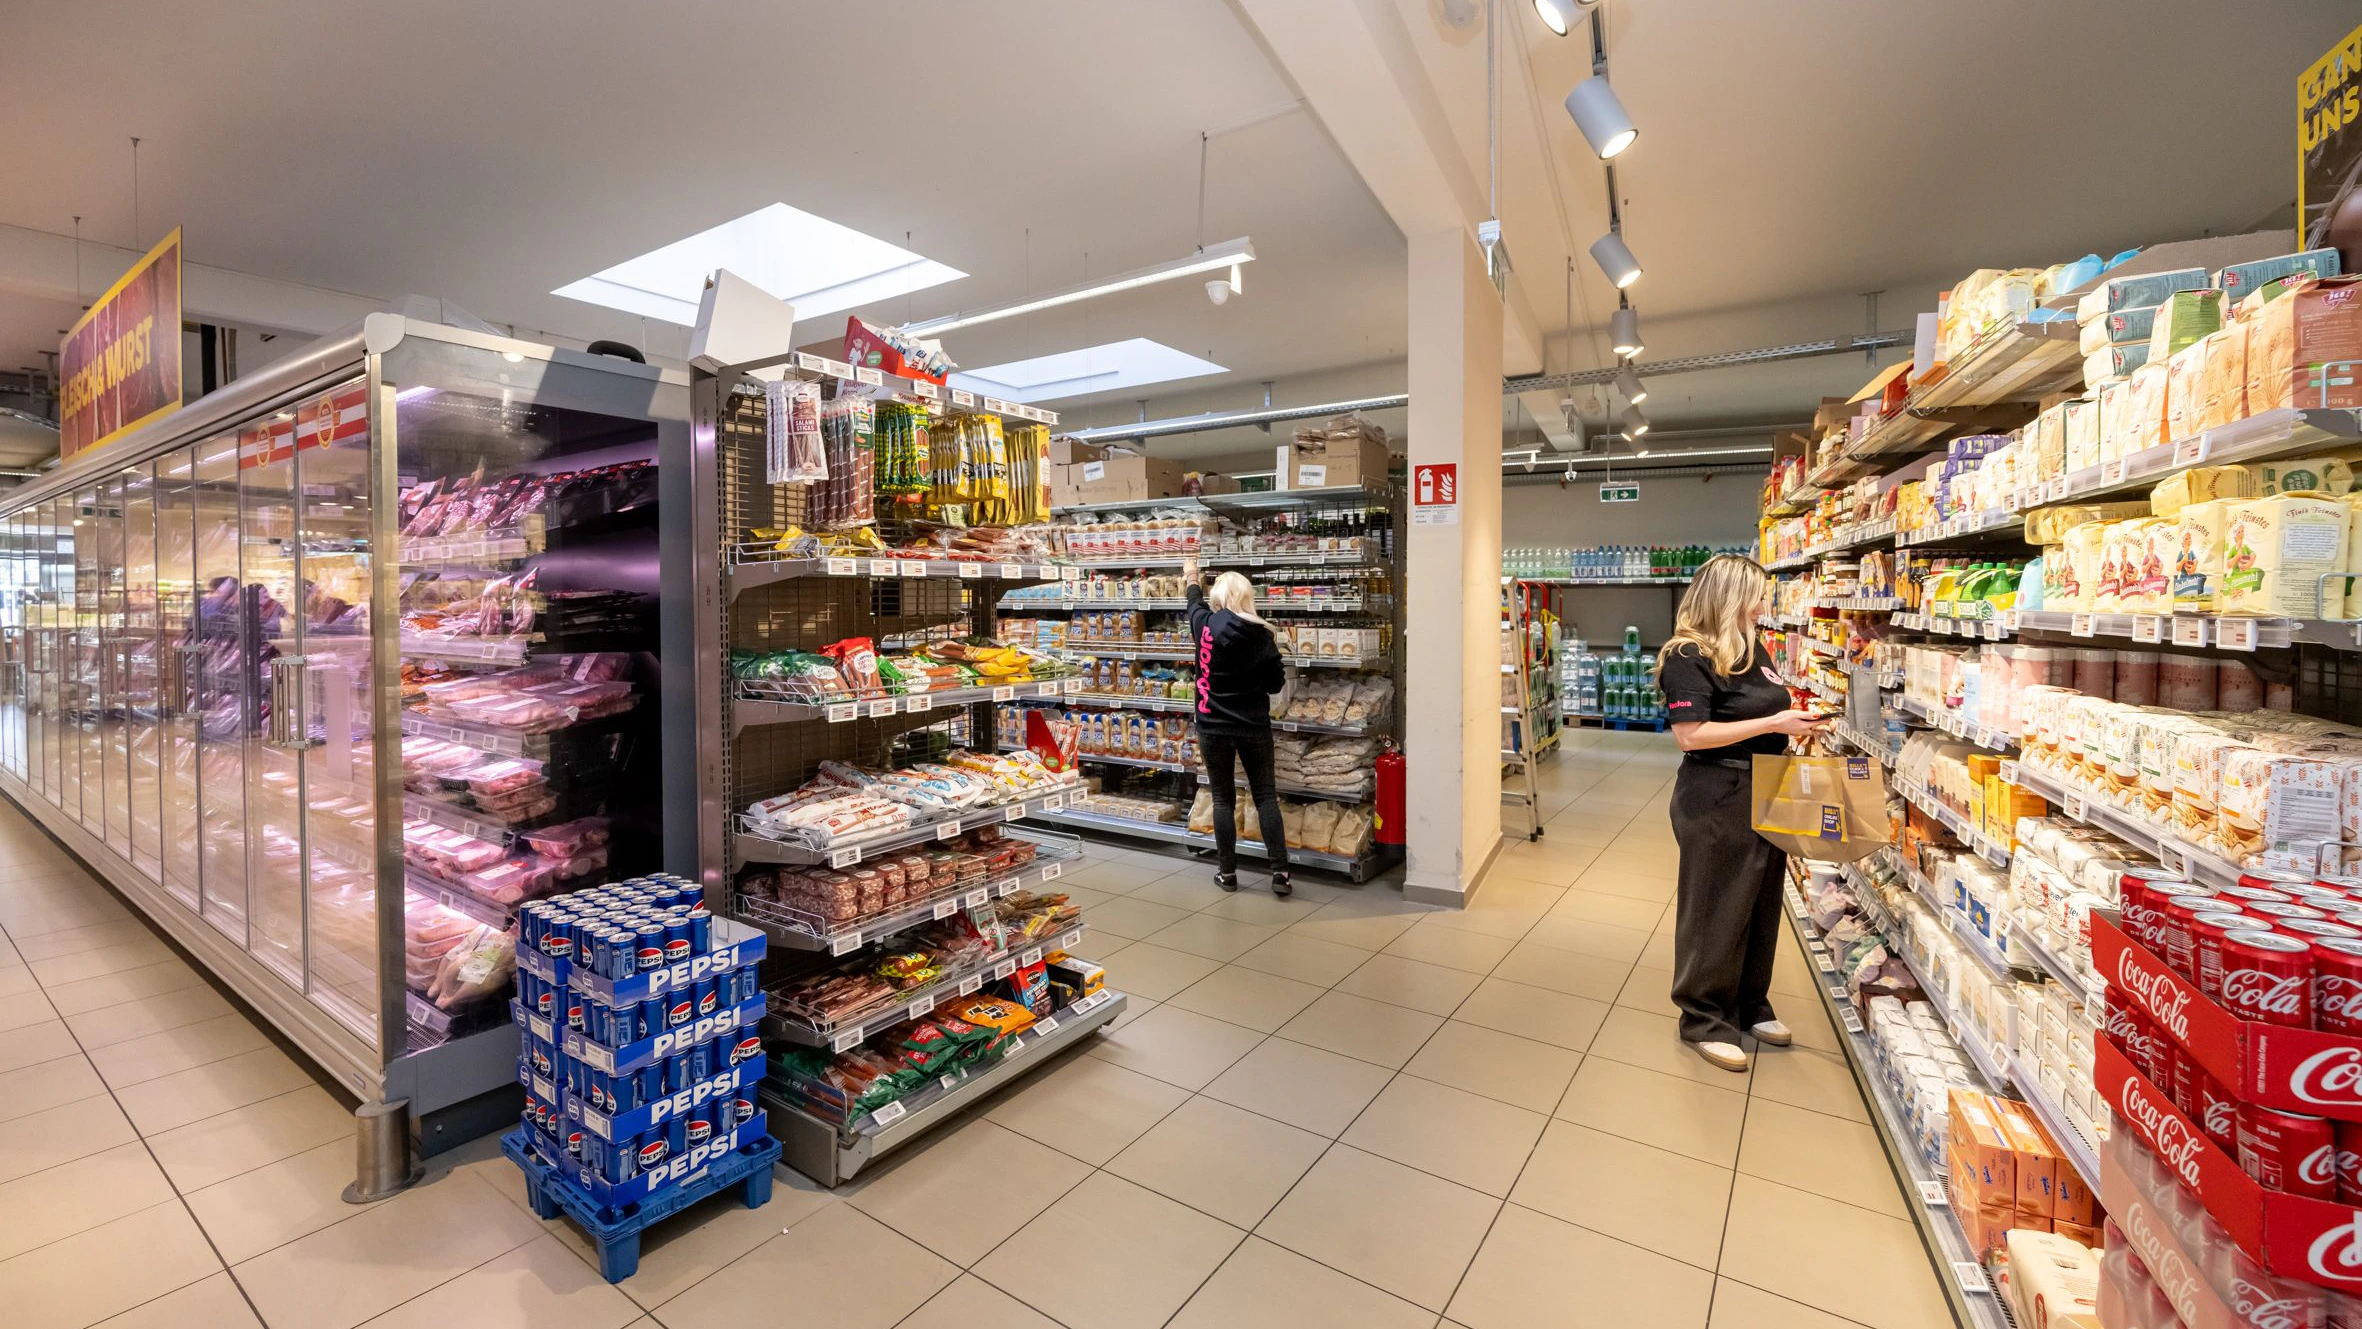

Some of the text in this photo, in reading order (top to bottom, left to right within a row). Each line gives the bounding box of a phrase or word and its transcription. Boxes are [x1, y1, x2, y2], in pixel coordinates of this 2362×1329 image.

[97, 352, 104, 397] &
[106, 315, 153, 389] WURST
[649, 945, 739, 994] PEPSI
[2119, 946, 2192, 1040] Coca-Cola
[654, 1005, 740, 1059] PEPSI
[651, 1067, 740, 1125] PEPSI
[2122, 1076, 2205, 1187] Coca-Cola
[648, 1129, 738, 1192] PEPSI
[2126, 1203, 2201, 1326] Coca-Cola
